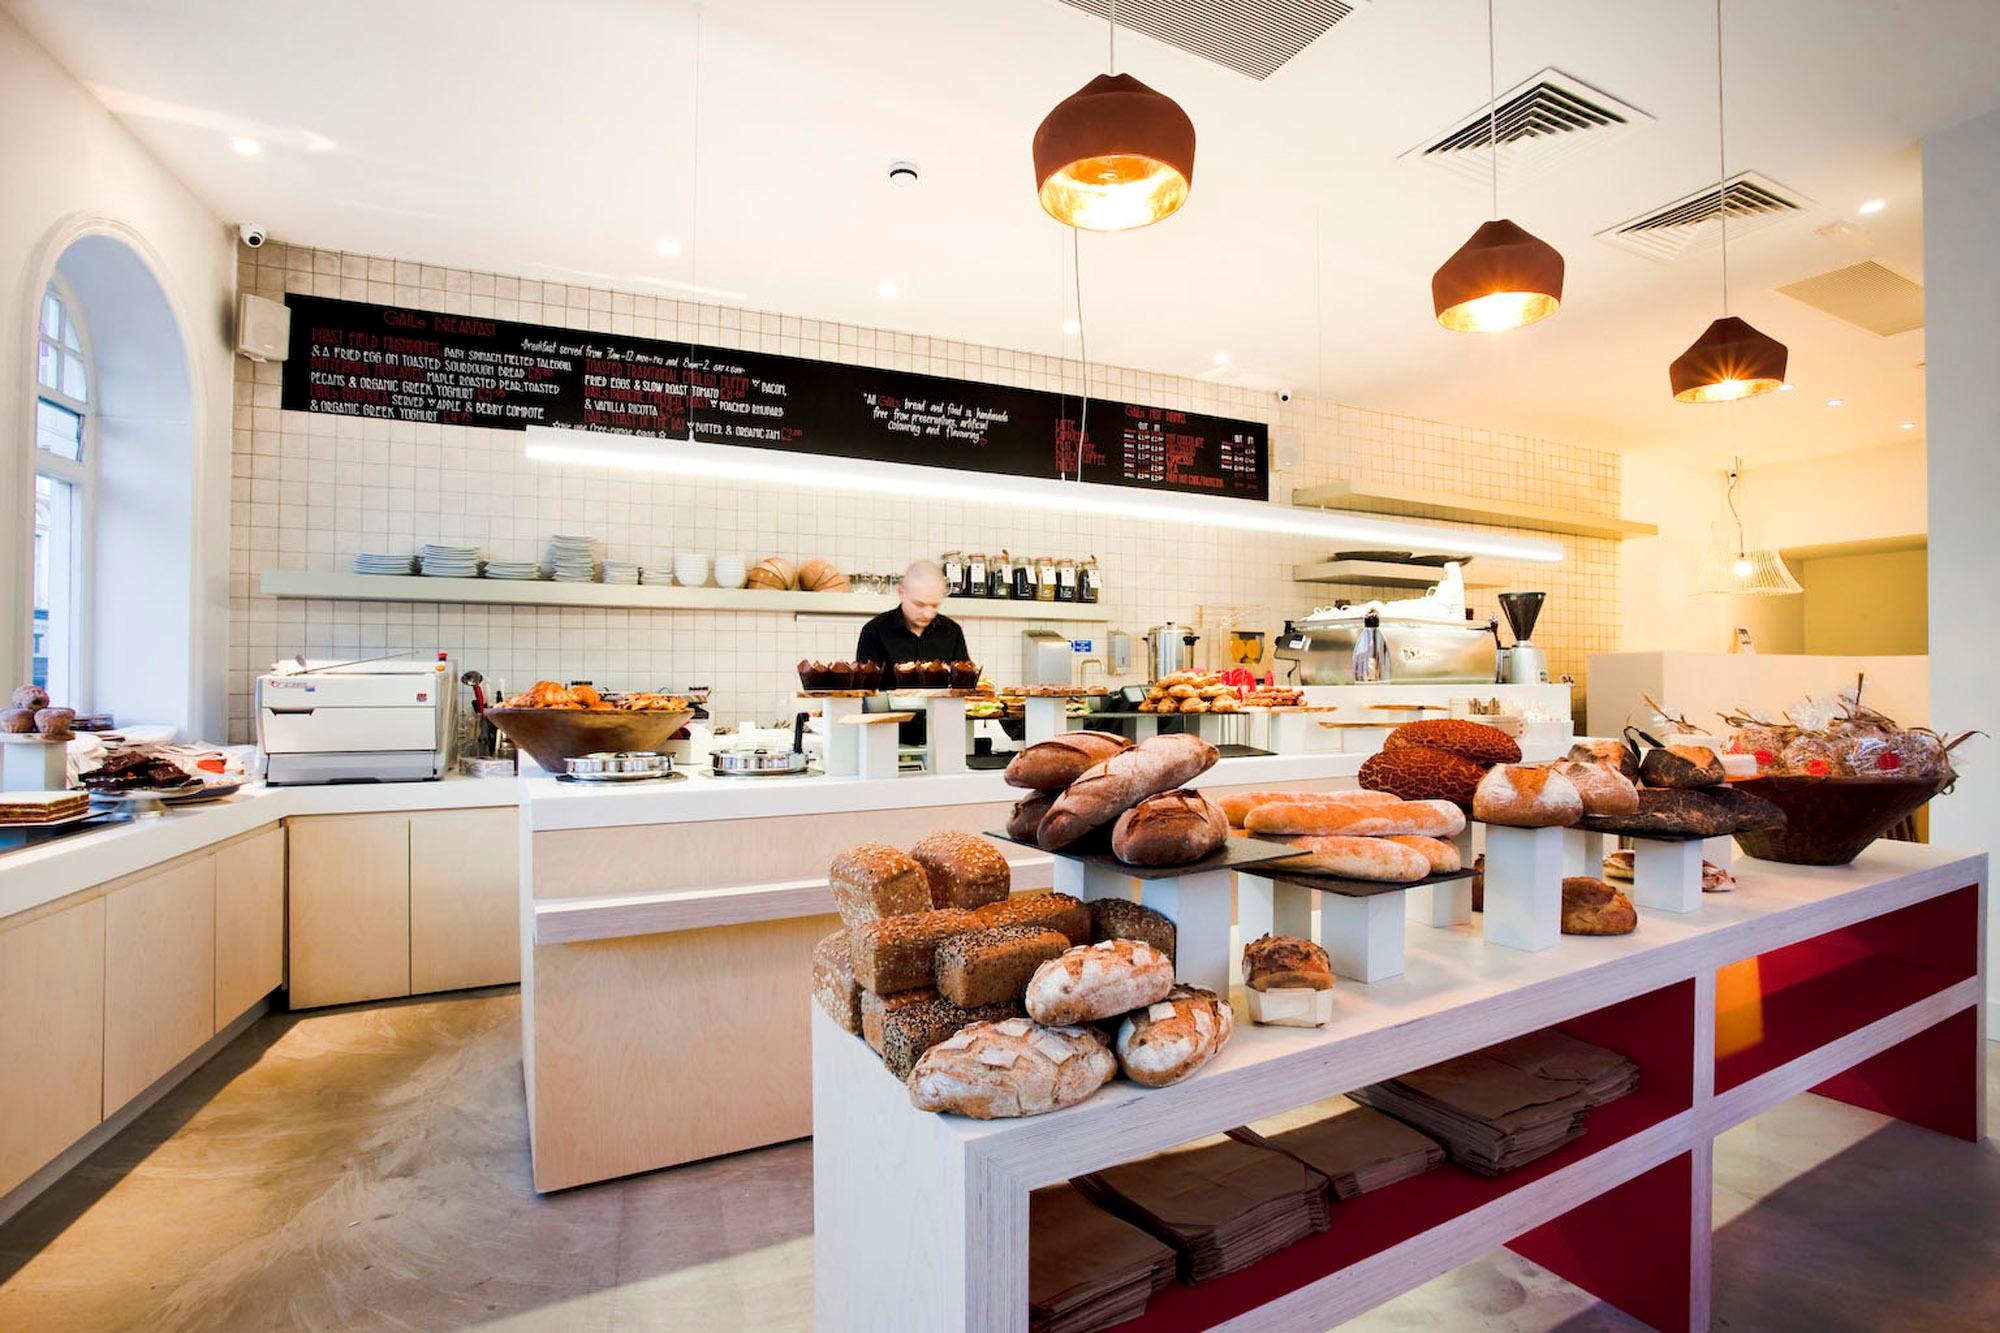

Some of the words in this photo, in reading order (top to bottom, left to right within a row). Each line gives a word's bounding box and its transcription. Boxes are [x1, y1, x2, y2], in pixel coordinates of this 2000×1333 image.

[434, 317, 498, 337] BREAKFAST
[311, 327, 345, 344] ROAST
[348, 332, 379, 348] FIELD
[444, 347, 465, 359] BABY
[504, 354, 534, 366] MELTED
[559, 344, 584, 356] served
[584, 345, 603, 359] from
[664, 356, 679, 367] and
[311, 344, 322, 356] &
[322, 346, 331, 357] A
[333, 348, 361, 361] FRIED
[363, 350, 382, 363] EGG
[384, 352, 398, 365] ON
[401, 355, 441, 370] TOASTED
[444, 361, 494, 375] SOURDOUGH
[498, 365, 525, 378] BREAD
[584, 359, 622, 376] TOASTED
[625, 364, 678, 382] TRADITIONAL
[310, 372, 345, 386] PECANS
[348, 375, 358, 388] &
[359, 378, 398, 391] ORGANIC
[402, 381, 433, 394] GREEK
[435, 385, 474, 399] YOGHURT
[426, 371, 455, 384] MAPLE
[458, 376, 496, 389] ROASTED
[523, 381, 561, 394] TOASTED
[584, 374, 607, 387] FRIED
[610, 377, 631, 389] EGGS
[633, 379, 642, 391] &
[641, 380, 663, 392] SLOW
[664, 383, 689, 396] ROAST
[690, 386, 719, 399] TOMATO
[310, 399, 319, 411] &
[319, 402, 360, 415] ORGANIC
[362, 404, 395, 418] GREEK
[398, 408, 438, 421] YOGHURT
[390, 394, 424, 407] SERVED
[436, 400, 461, 411] APPLE
[464, 401, 474, 412] &
[475, 402, 503, 415] BERRY
[505, 406, 545, 419] COMPOTE
[584, 398, 593, 410] &
[593, 400, 625, 413] VANILLA
[627, 403, 658, 416] RICOTTA
[719, 401, 749, 414] POACHED
[751, 404, 785, 417] RHUBARB
[872, 406, 888, 419] free
[893, 407, 910, 420] from
[904, 398, 926, 411] bread
[929, 401, 944, 413] and
[946, 402, 963, 415] food
[695, 421, 723, 434] BUTTER
[725, 424, 733, 435] &
[734, 426, 765, 439] ORGANIC
[766, 428, 780, 440] JAM
[925, 425, 940, 436] and
